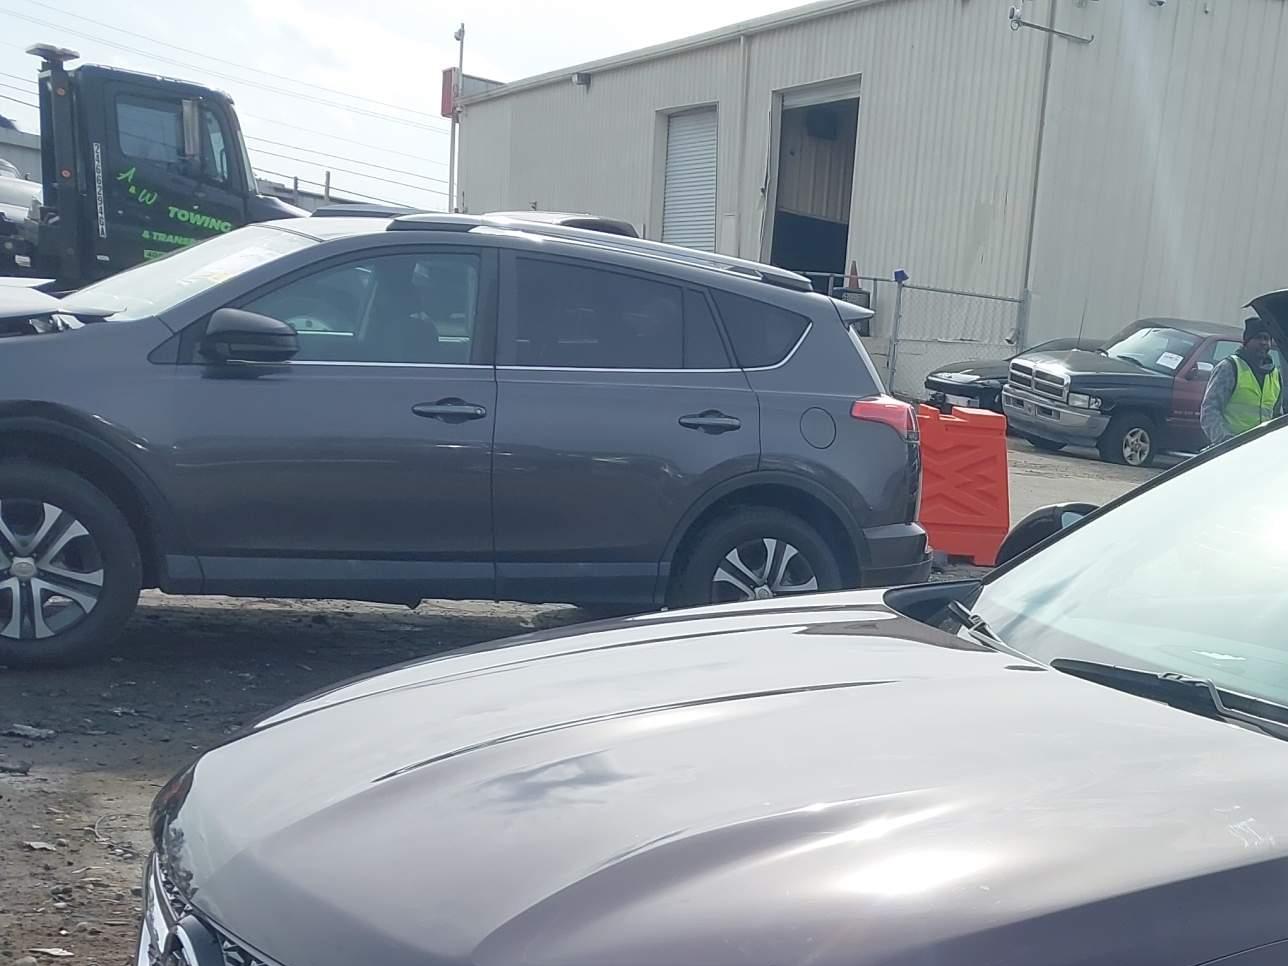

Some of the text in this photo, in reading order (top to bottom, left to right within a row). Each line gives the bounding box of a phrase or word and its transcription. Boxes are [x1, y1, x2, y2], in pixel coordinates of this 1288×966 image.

[116, 167, 158, 205] A & W
[168, 206, 232, 232] TOWING
